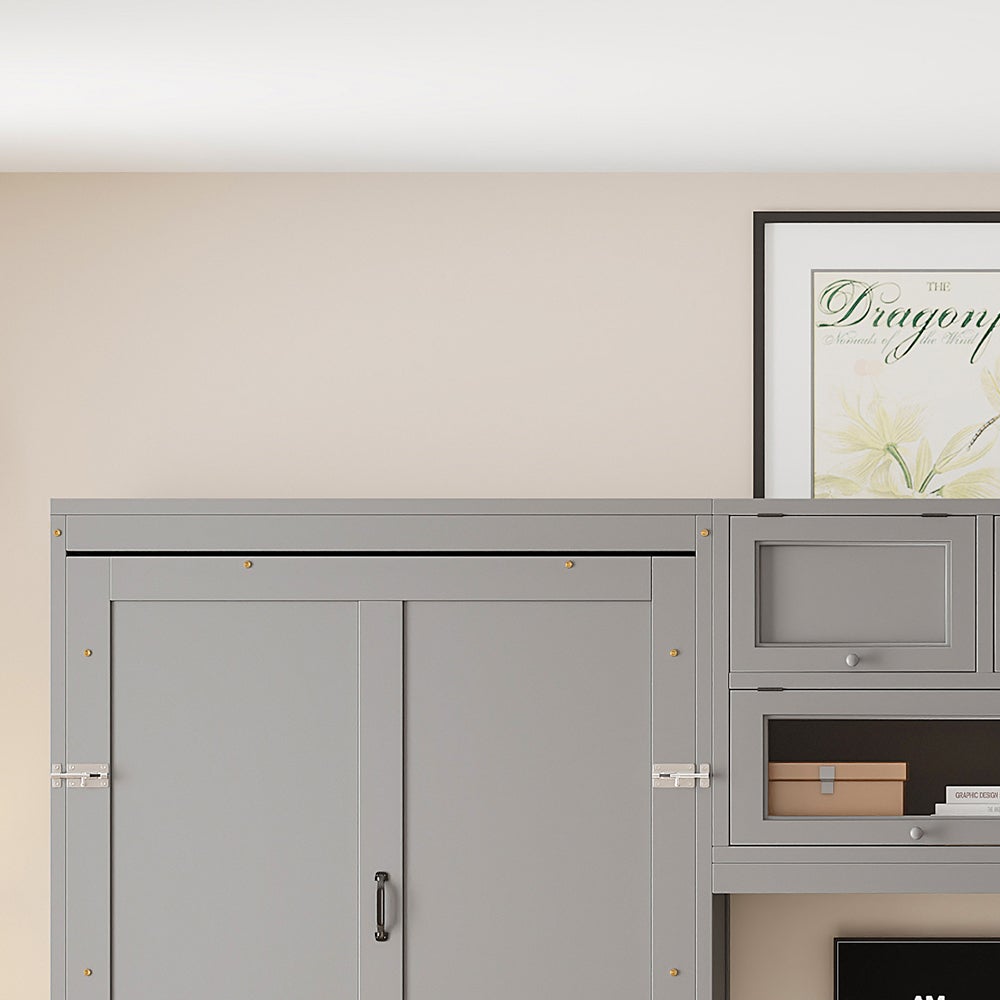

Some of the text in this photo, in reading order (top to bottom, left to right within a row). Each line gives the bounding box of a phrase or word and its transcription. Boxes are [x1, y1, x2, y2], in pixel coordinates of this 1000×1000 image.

[926, 281, 951, 292] THE
[919, 332, 937, 346] the
[955, 791, 979, 799] GRAPHIC
[979, 791, 999, 799] DESIGN
